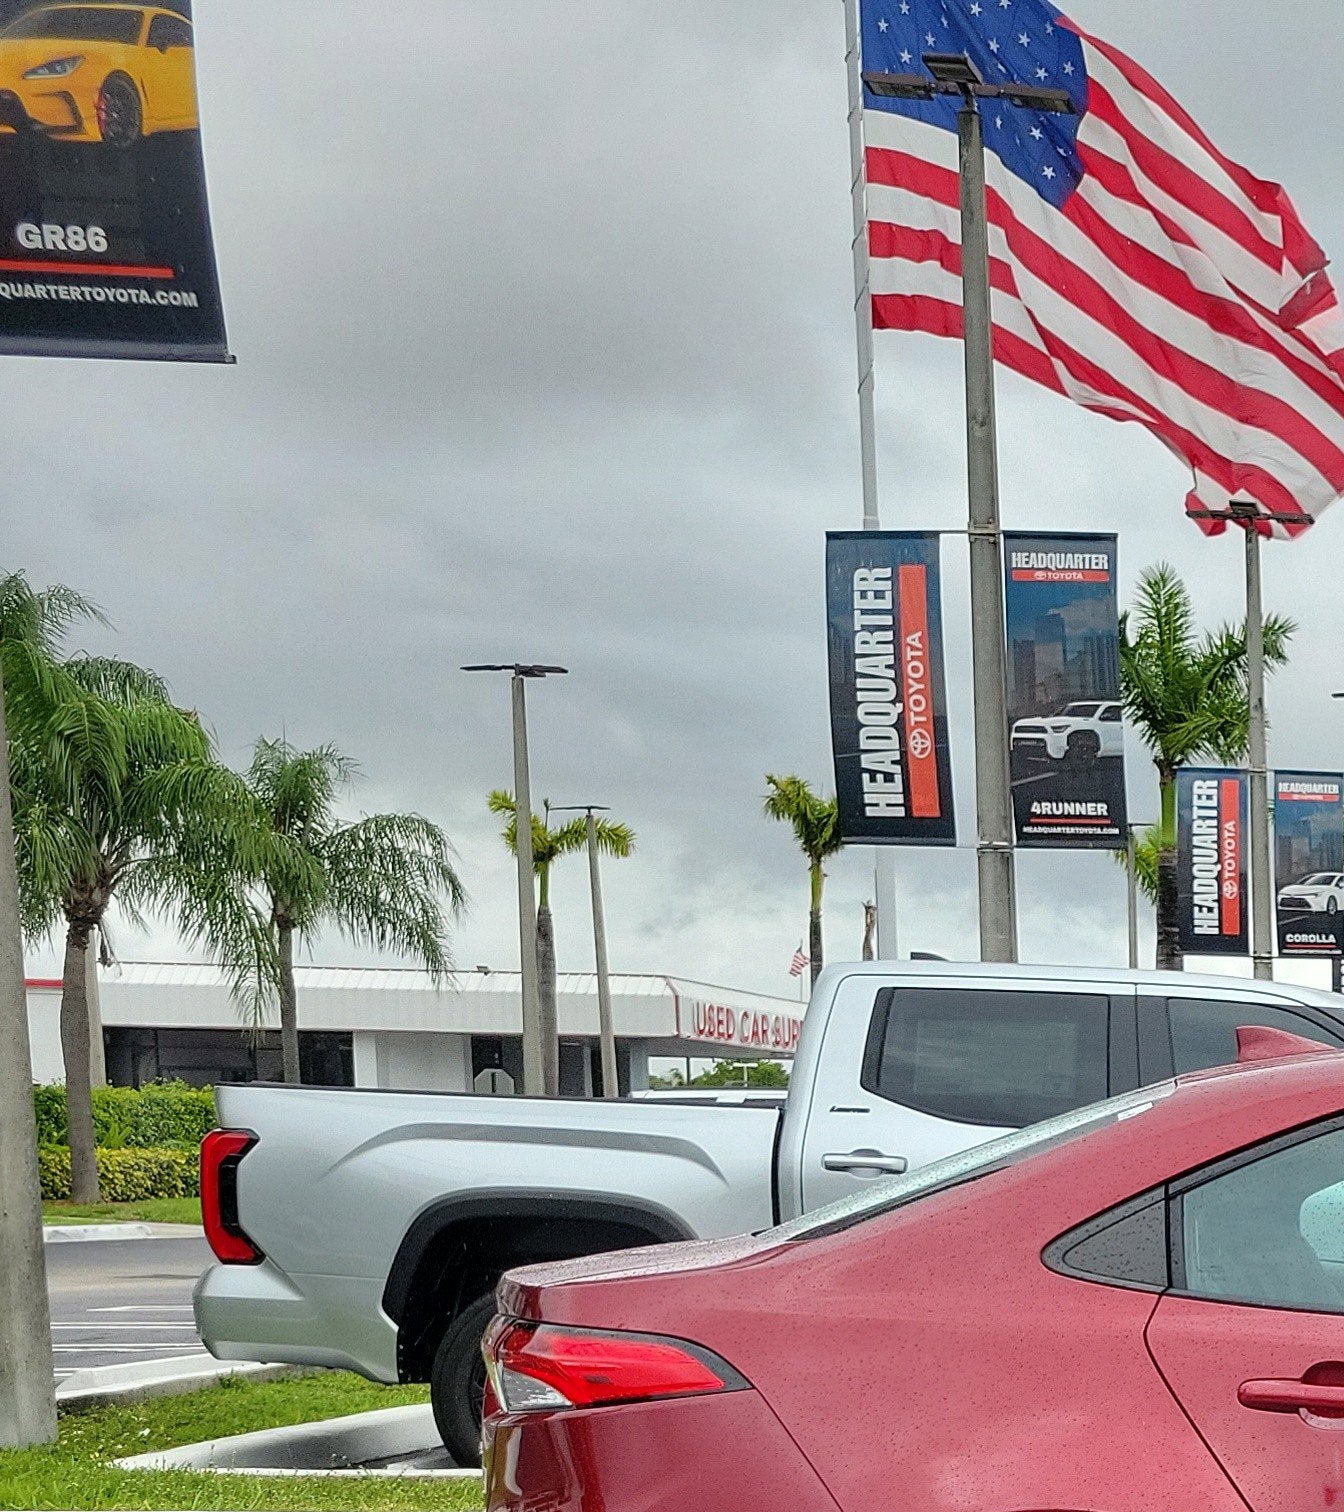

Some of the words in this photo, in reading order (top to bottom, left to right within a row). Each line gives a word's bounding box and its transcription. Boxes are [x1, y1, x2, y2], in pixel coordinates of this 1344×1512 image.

[17, 223, 108, 253] GR86
[0, 282, 199, 308] QUARTERTOYOTA.COM
[1011, 552, 1109, 570] HEADQUARTER
[1048, 571, 1084, 580] TOYOTA
[853, 566, 906, 818] HEADQUARTER
[906, 631, 928, 726] TOYOTA
[1030, 801, 1109, 816] 4RUNNER
[1192, 779, 1222, 935] HEADQUARTER
[1224, 820, 1236, 879] TOYOTA
[1285, 933, 1337, 943] COROLLA
[693, 1002, 735, 1040] USED
[740, 1011, 770, 1045] CAR
[772, 1014, 804, 1049] SUP
